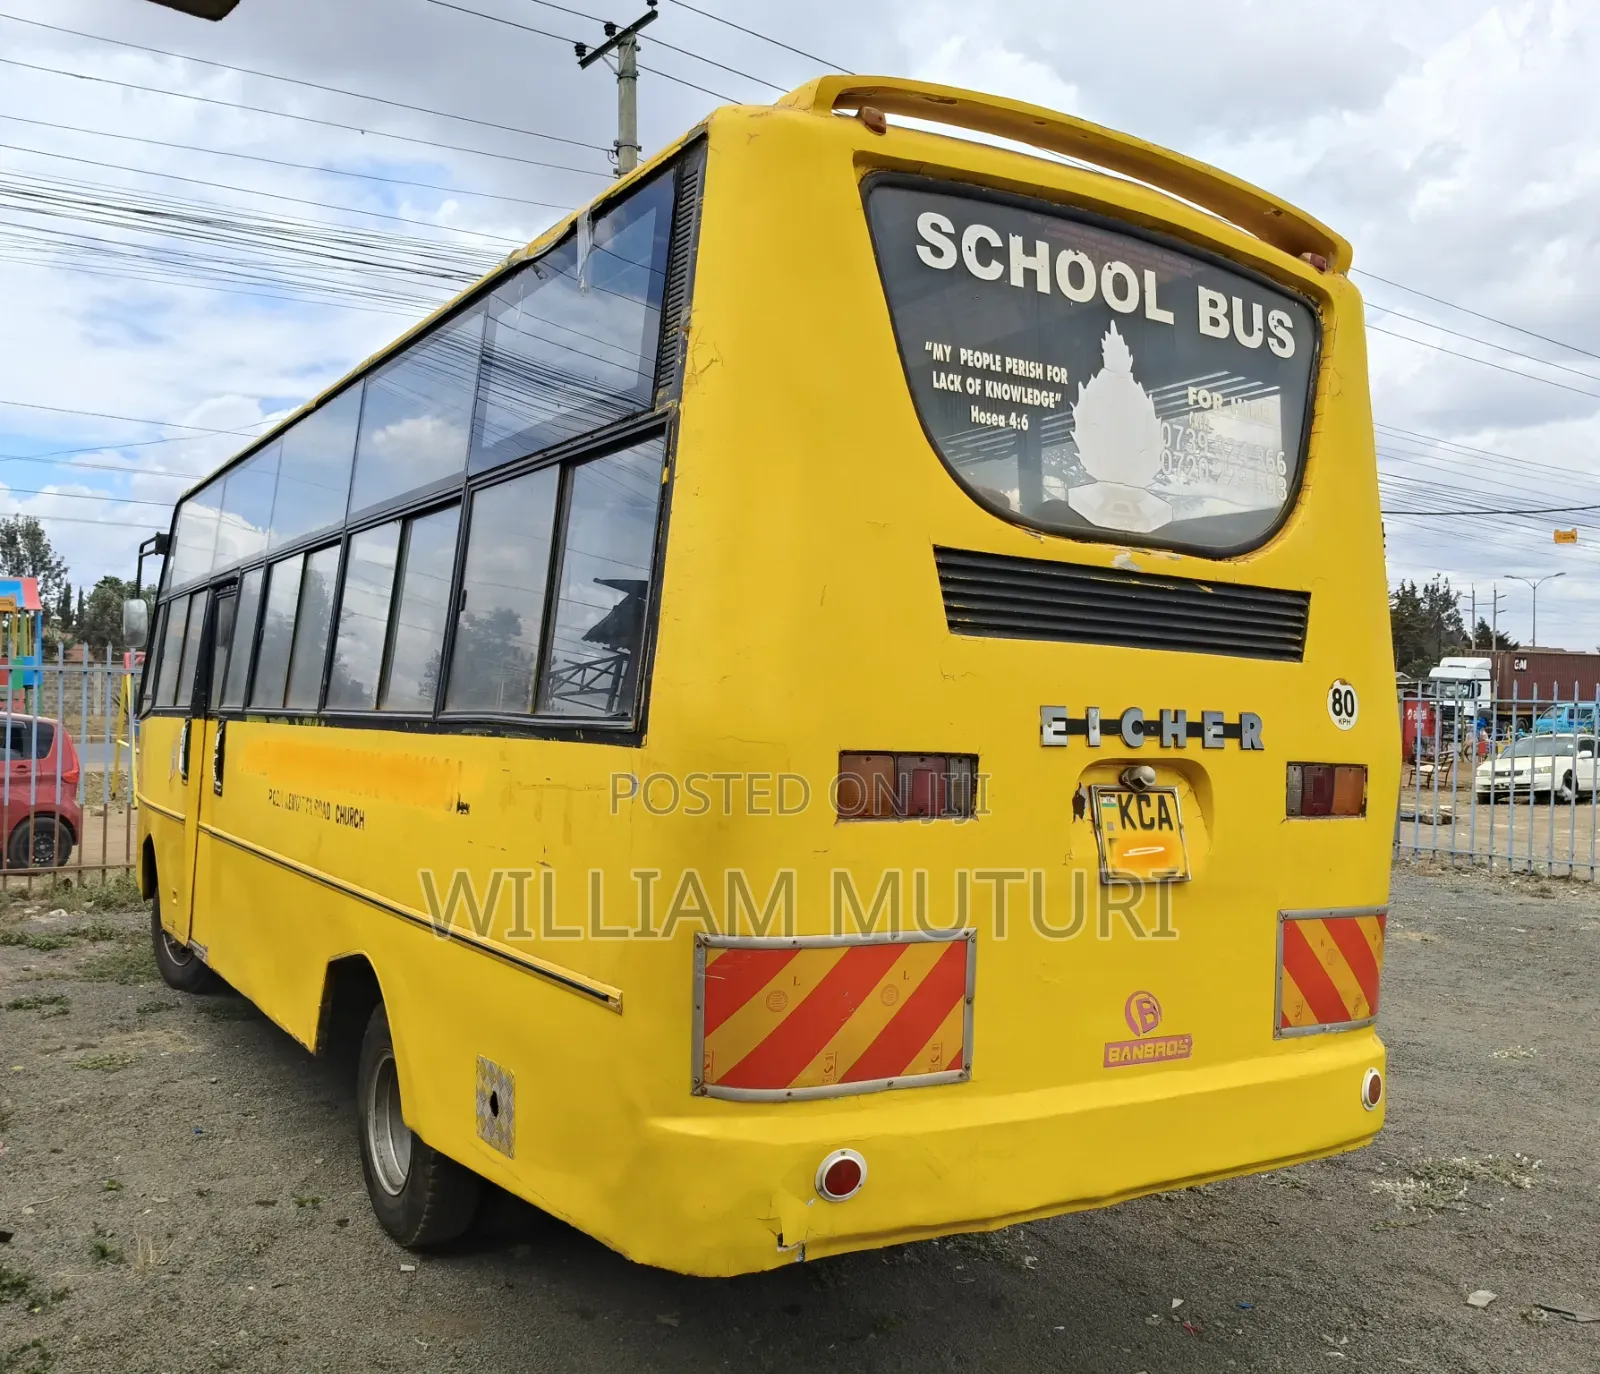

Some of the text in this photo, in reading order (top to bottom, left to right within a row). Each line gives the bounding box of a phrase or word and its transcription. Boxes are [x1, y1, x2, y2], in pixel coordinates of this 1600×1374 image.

[915, 212, 1175, 326] SCHOOL
[1198, 285, 1296, 358] BUS
[960, 348, 1002, 372] PEOPLE
[1005, 356, 1044, 380] PERISH
[1046, 364, 1068, 384] FOR
[932, 370, 962, 393] LACK
[966, 376, 982, 396] OF
[1187, 386, 1223, 410] FOR
[970, 405, 1029, 431] Hosea 4:6
[1332, 688, 1355, 718] 80
[1040, 705, 1265, 750] EICHER
[1338, 718, 1351, 726] KPH
[335, 804, 365, 831] CHURCH
[1117, 793, 1174, 831] KCA
[793, 976, 800, 986] L
